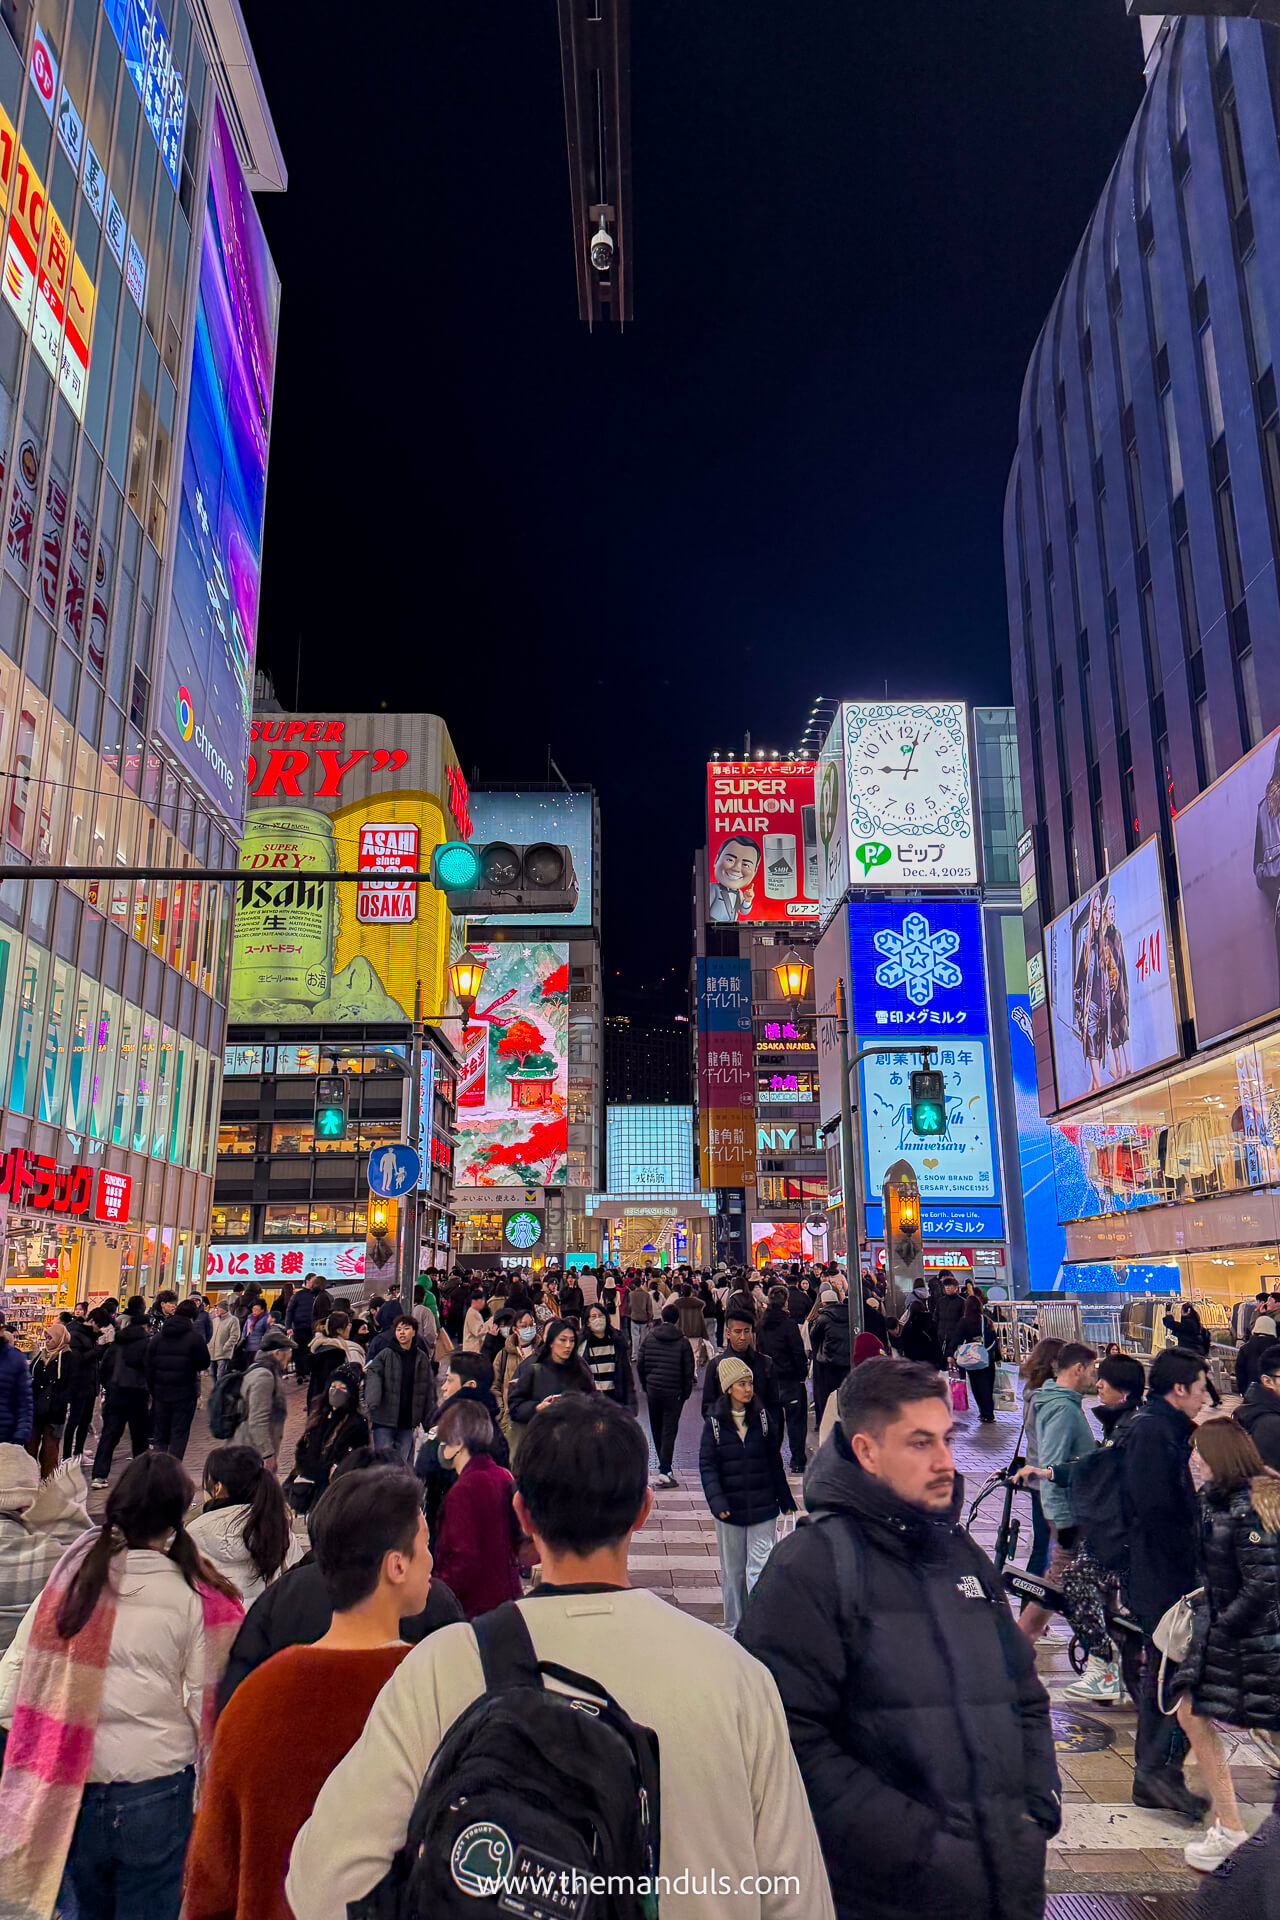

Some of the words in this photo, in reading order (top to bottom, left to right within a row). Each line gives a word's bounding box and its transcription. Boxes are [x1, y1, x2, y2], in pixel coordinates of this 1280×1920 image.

[35, 49, 52, 91] 6F
[43, 278, 56, 308] 5F
[250, 720, 345, 742] SUPER
[879, 730, 893, 744] 11
[899, 726, 913, 739] 12
[922, 732, 930, 742] 1
[195, 724, 233, 790] chrome
[863, 743, 879, 759] 10
[935, 746, 948, 757] 2
[860, 766, 873, 775] 9
[942, 766, 955, 774] 3
[714, 780, 787, 795] SUPER
[867, 785, 880, 795] 8
[938, 784, 951, 795] 4
[714, 798, 795, 814] MILLION
[885, 798, 897, 809] 7
[905, 802, 915, 815] 6
[925, 796, 936, 809] 5
[715, 817, 769, 832] HAIR
[262, 843, 298, 852] SUPER
[362, 832, 414, 856] ASAHI
[897, 844, 945, 862] ピップ
[376, 857, 400, 865] since
[903, 867, 927, 877] Dec.
[941, 867, 971, 877] 2025
[235, 880, 325, 911] Asahi
[361, 895, 411, 917] OSAKA
[263, 915, 286, 930] 生
[245, 944, 303, 954] スーパードライ
[1136, 928, 1160, 984] H&M
[706, 976, 741, 992] 龍角散
[875, 1009, 966, 1024] 雪印メグミルク
[756, 1042, 785, 1051] OSAKA
[786, 1042, 816, 1051] NANBA
[708, 1051, 742, 1067] 龍角散
[769, 1074, 798, 1089] 力丸
[709, 1129, 744, 1145] 龍角散
[758, 1129, 797, 1150] NY
[895, 1141, 966, 1153] Anniversary
[104, 1174, 127, 1188] SUNDRUG
[461, 1194, 520, 1203] ぶいぶい、使える。
[922, 1219, 985, 1233] 印メグミルク
[500, 1256, 559, 1268] TSUTYA
[923, 1256, 970, 1267] TTERIA
[1014, 1579, 1044, 1594] FLYFISH
